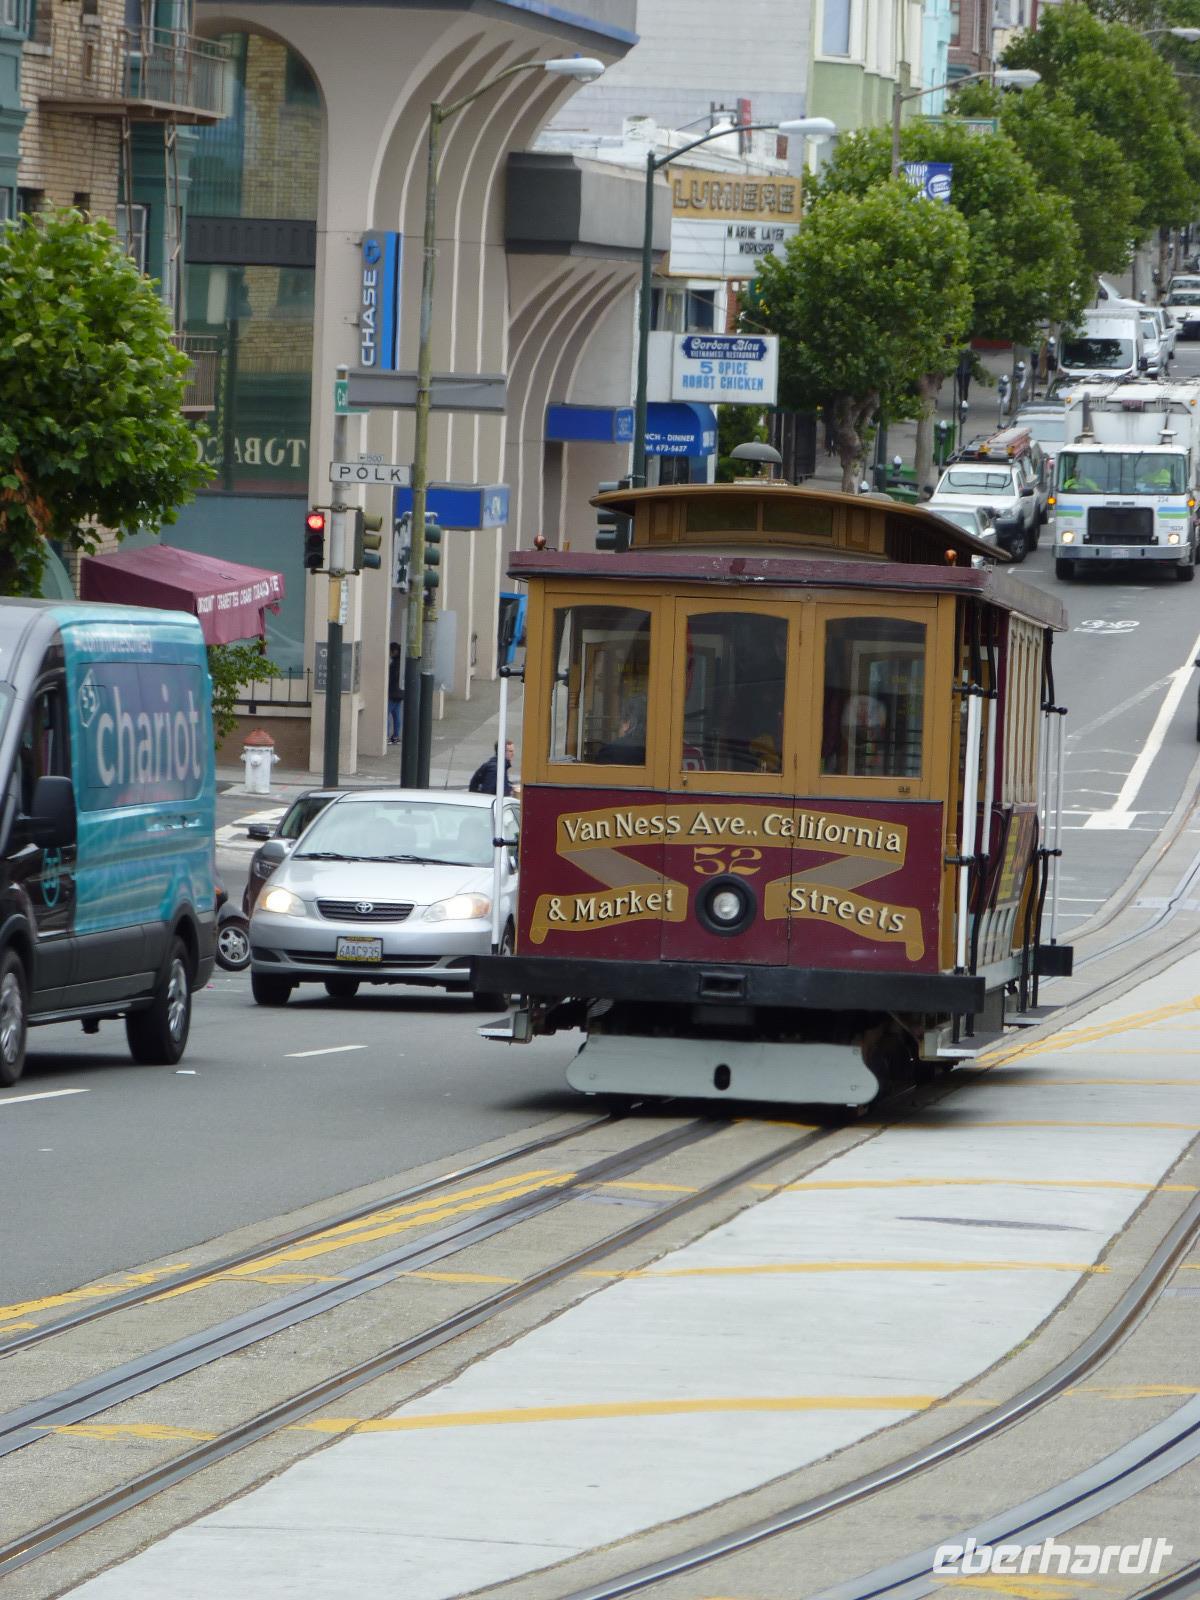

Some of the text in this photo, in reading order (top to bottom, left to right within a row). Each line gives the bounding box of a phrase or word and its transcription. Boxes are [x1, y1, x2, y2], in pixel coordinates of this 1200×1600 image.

[673, 178, 796, 213] LUMIERE
[727, 224, 785, 240] MARINE LAYER
[739, 242, 775, 255] WORKSHOP
[362, 269, 377, 366] CHASE
[691, 350, 760, 359] VIETNAMESE RESTAURANT
[700, 361, 748, 375] 5 SPICE
[682, 375, 764, 391] ROAST CHICKEN
[645, 433, 661, 441] NCH
[667, 434, 695, 442] DINNER
[340, 466, 401, 481] POLK
[97, 683, 201, 787] chariot
[563, 817, 612, 843] Van
[614, 811, 681, 839] Ness
[763, 812, 902, 853] California
[693, 846, 763, 876] 52
[548, 887, 907, 934] & Market Streets
